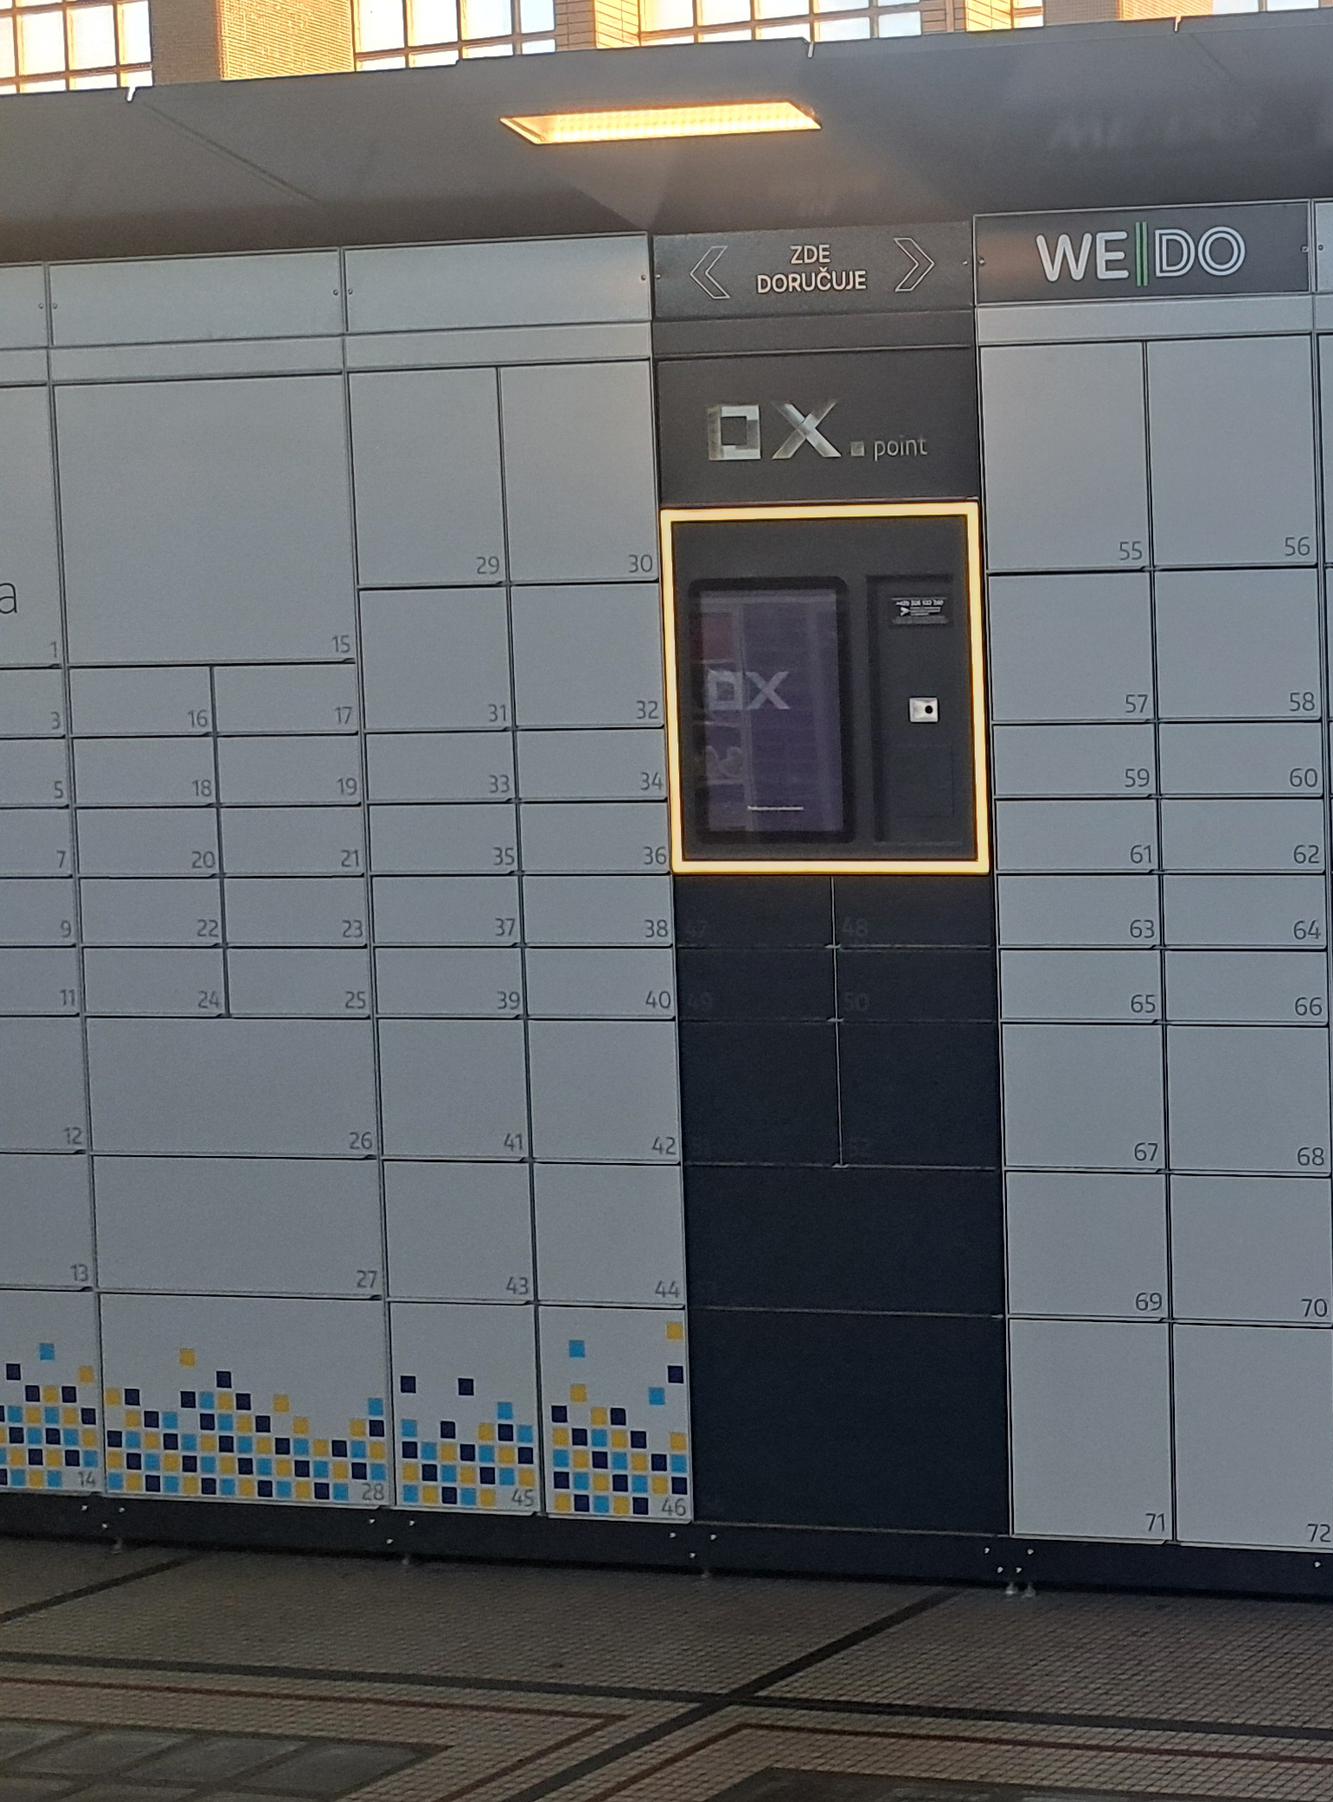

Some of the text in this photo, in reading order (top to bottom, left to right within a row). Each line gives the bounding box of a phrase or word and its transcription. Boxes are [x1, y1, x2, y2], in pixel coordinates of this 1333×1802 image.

[790, 243, 831, 265] ZDE
[756, 263, 867, 295] DORUČUJE
[1119, 540, 1143, 561] 55
[1284, 536, 1311, 557] 56
[476, 555, 500, 575] 29
[628, 553, 653, 574] 30
[50, 640, 58, 659] 1
[331, 634, 351, 654] 15
[636, 699, 659, 720] 32
[1125, 693, 1149, 714] 57
[1289, 691, 1316, 712] 58
[51, 711, 61, 730] 3
[187, 709, 208, 728] 16
[335, 706, 353, 725] 17
[488, 703, 507, 723] 31
[337, 777, 358, 796] 19
[489, 774, 510, 794] 33
[640, 771, 663, 791] 34
[1124, 767, 1150, 788] 59
[1289, 767, 1318, 788] 60
[54, 780, 64, 799] 5
[191, 779, 212, 798] 18
[56, 850, 67, 869] 7
[191, 850, 216, 869] 20
[340, 849, 360, 868] 21
[493, 846, 515, 866] 35
[643, 845, 667, 866] 36
[1129, 844, 1152, 865] 61
[1293, 844, 1320, 865] 62
[60, 919, 72, 938] 9
[196, 918, 219, 938] 22
[342, 919, 364, 938] 23
[495, 917, 516, 937] 37
[644, 919, 669, 938] 38
[842, 916, 869, 938] 48
[1129, 919, 1155, 939] 63
[1293, 919, 1322, 941] 64
[60, 989, 75, 1006] 11
[197, 990, 220, 1009] 24
[344, 990, 366, 1010] 25
[497, 990, 521, 1011] 39
[645, 990, 672, 1010] 40
[1130, 993, 1156, 1014] 65
[1294, 996, 1323, 1017] 66
[64, 1129, 84, 1147] 12
[349, 1131, 373, 1150] 26
[503, 1132, 523, 1152] 41
[651, 1136, 677, 1156] 42
[1134, 1141, 1159, 1162] 67
[1296, 1146, 1325, 1167] 68
[70, 1263, 89, 1282] 13
[356, 1269, 378, 1289] 27
[505, 1276, 529, 1296] 43
[654, 1280, 681, 1299] 44
[1135, 1291, 1163, 1312] 69
[1300, 1298, 1328, 1318] 70
[77, 1470, 97, 1488] 14
[361, 1482, 385, 1501] 28
[511, 1488, 535, 1508] 45
[661, 1497, 687, 1517] 46
[1144, 1512, 1166, 1533] 71
[1306, 1523, 1332, 1543] 72
